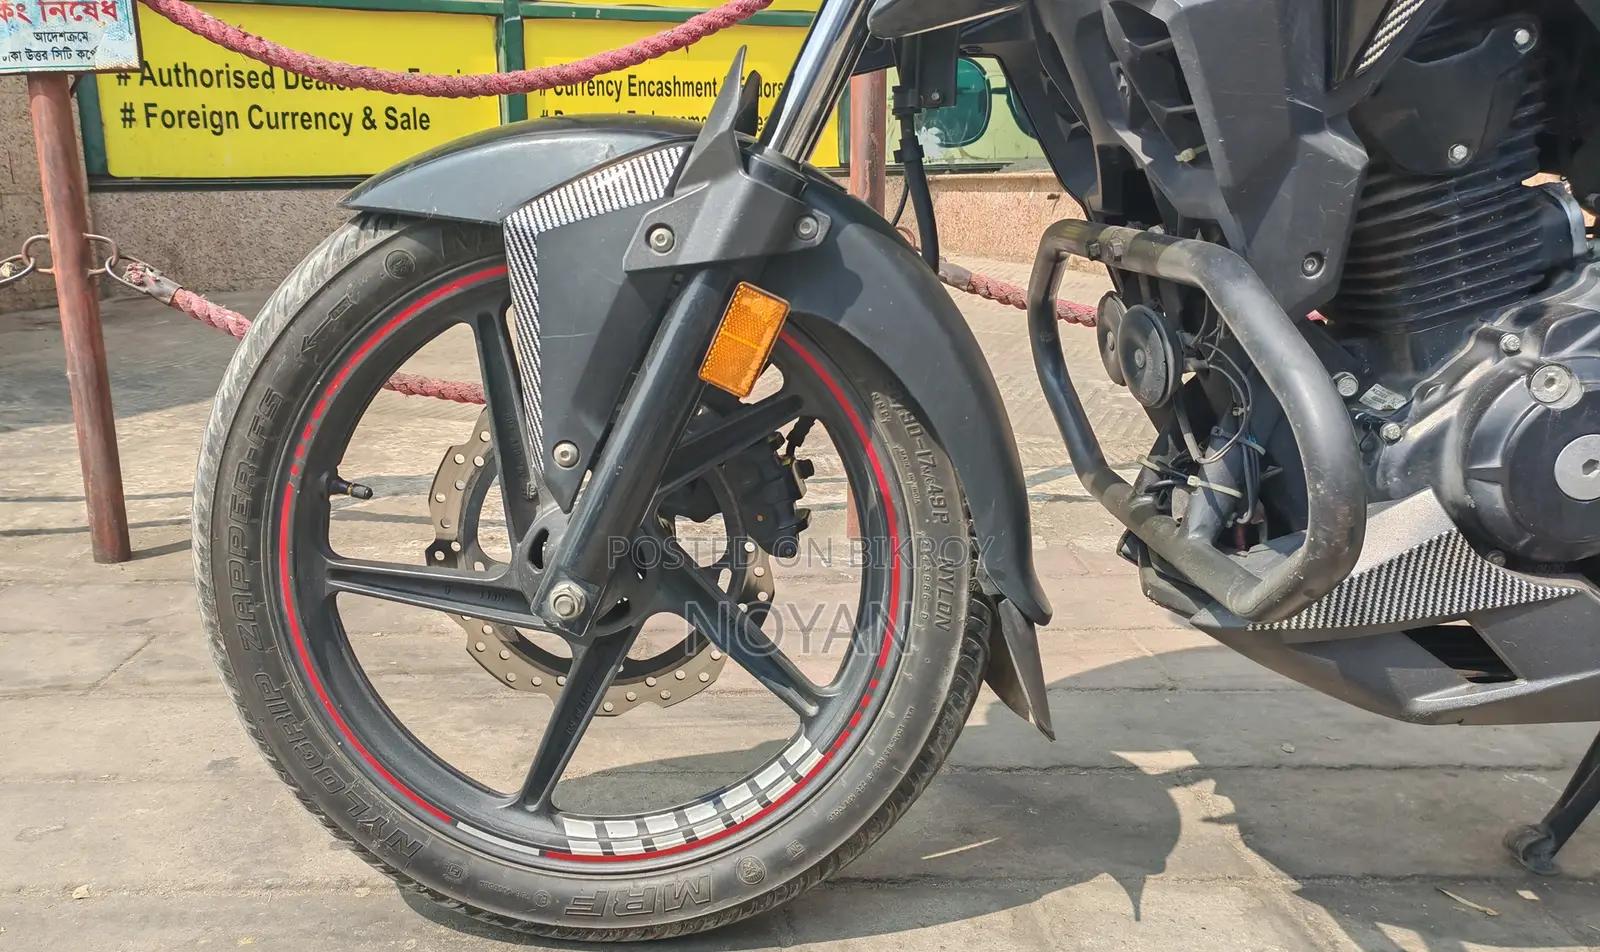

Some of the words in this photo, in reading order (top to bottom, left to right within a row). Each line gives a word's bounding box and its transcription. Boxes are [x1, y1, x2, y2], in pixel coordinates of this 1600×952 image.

[139, 60, 275, 90] Authorised
[627, 74, 718, 97] Encashment
[143, 102, 239, 136] Foreign
[247, 104, 353, 136] Currency
[361, 105, 378, 130] &
[384, 105, 431, 130] Sale
[934, 556, 955, 632] NYLON
[253, 671, 424, 859] NYLOGRIP
[563, 874, 714, 918] MRF
